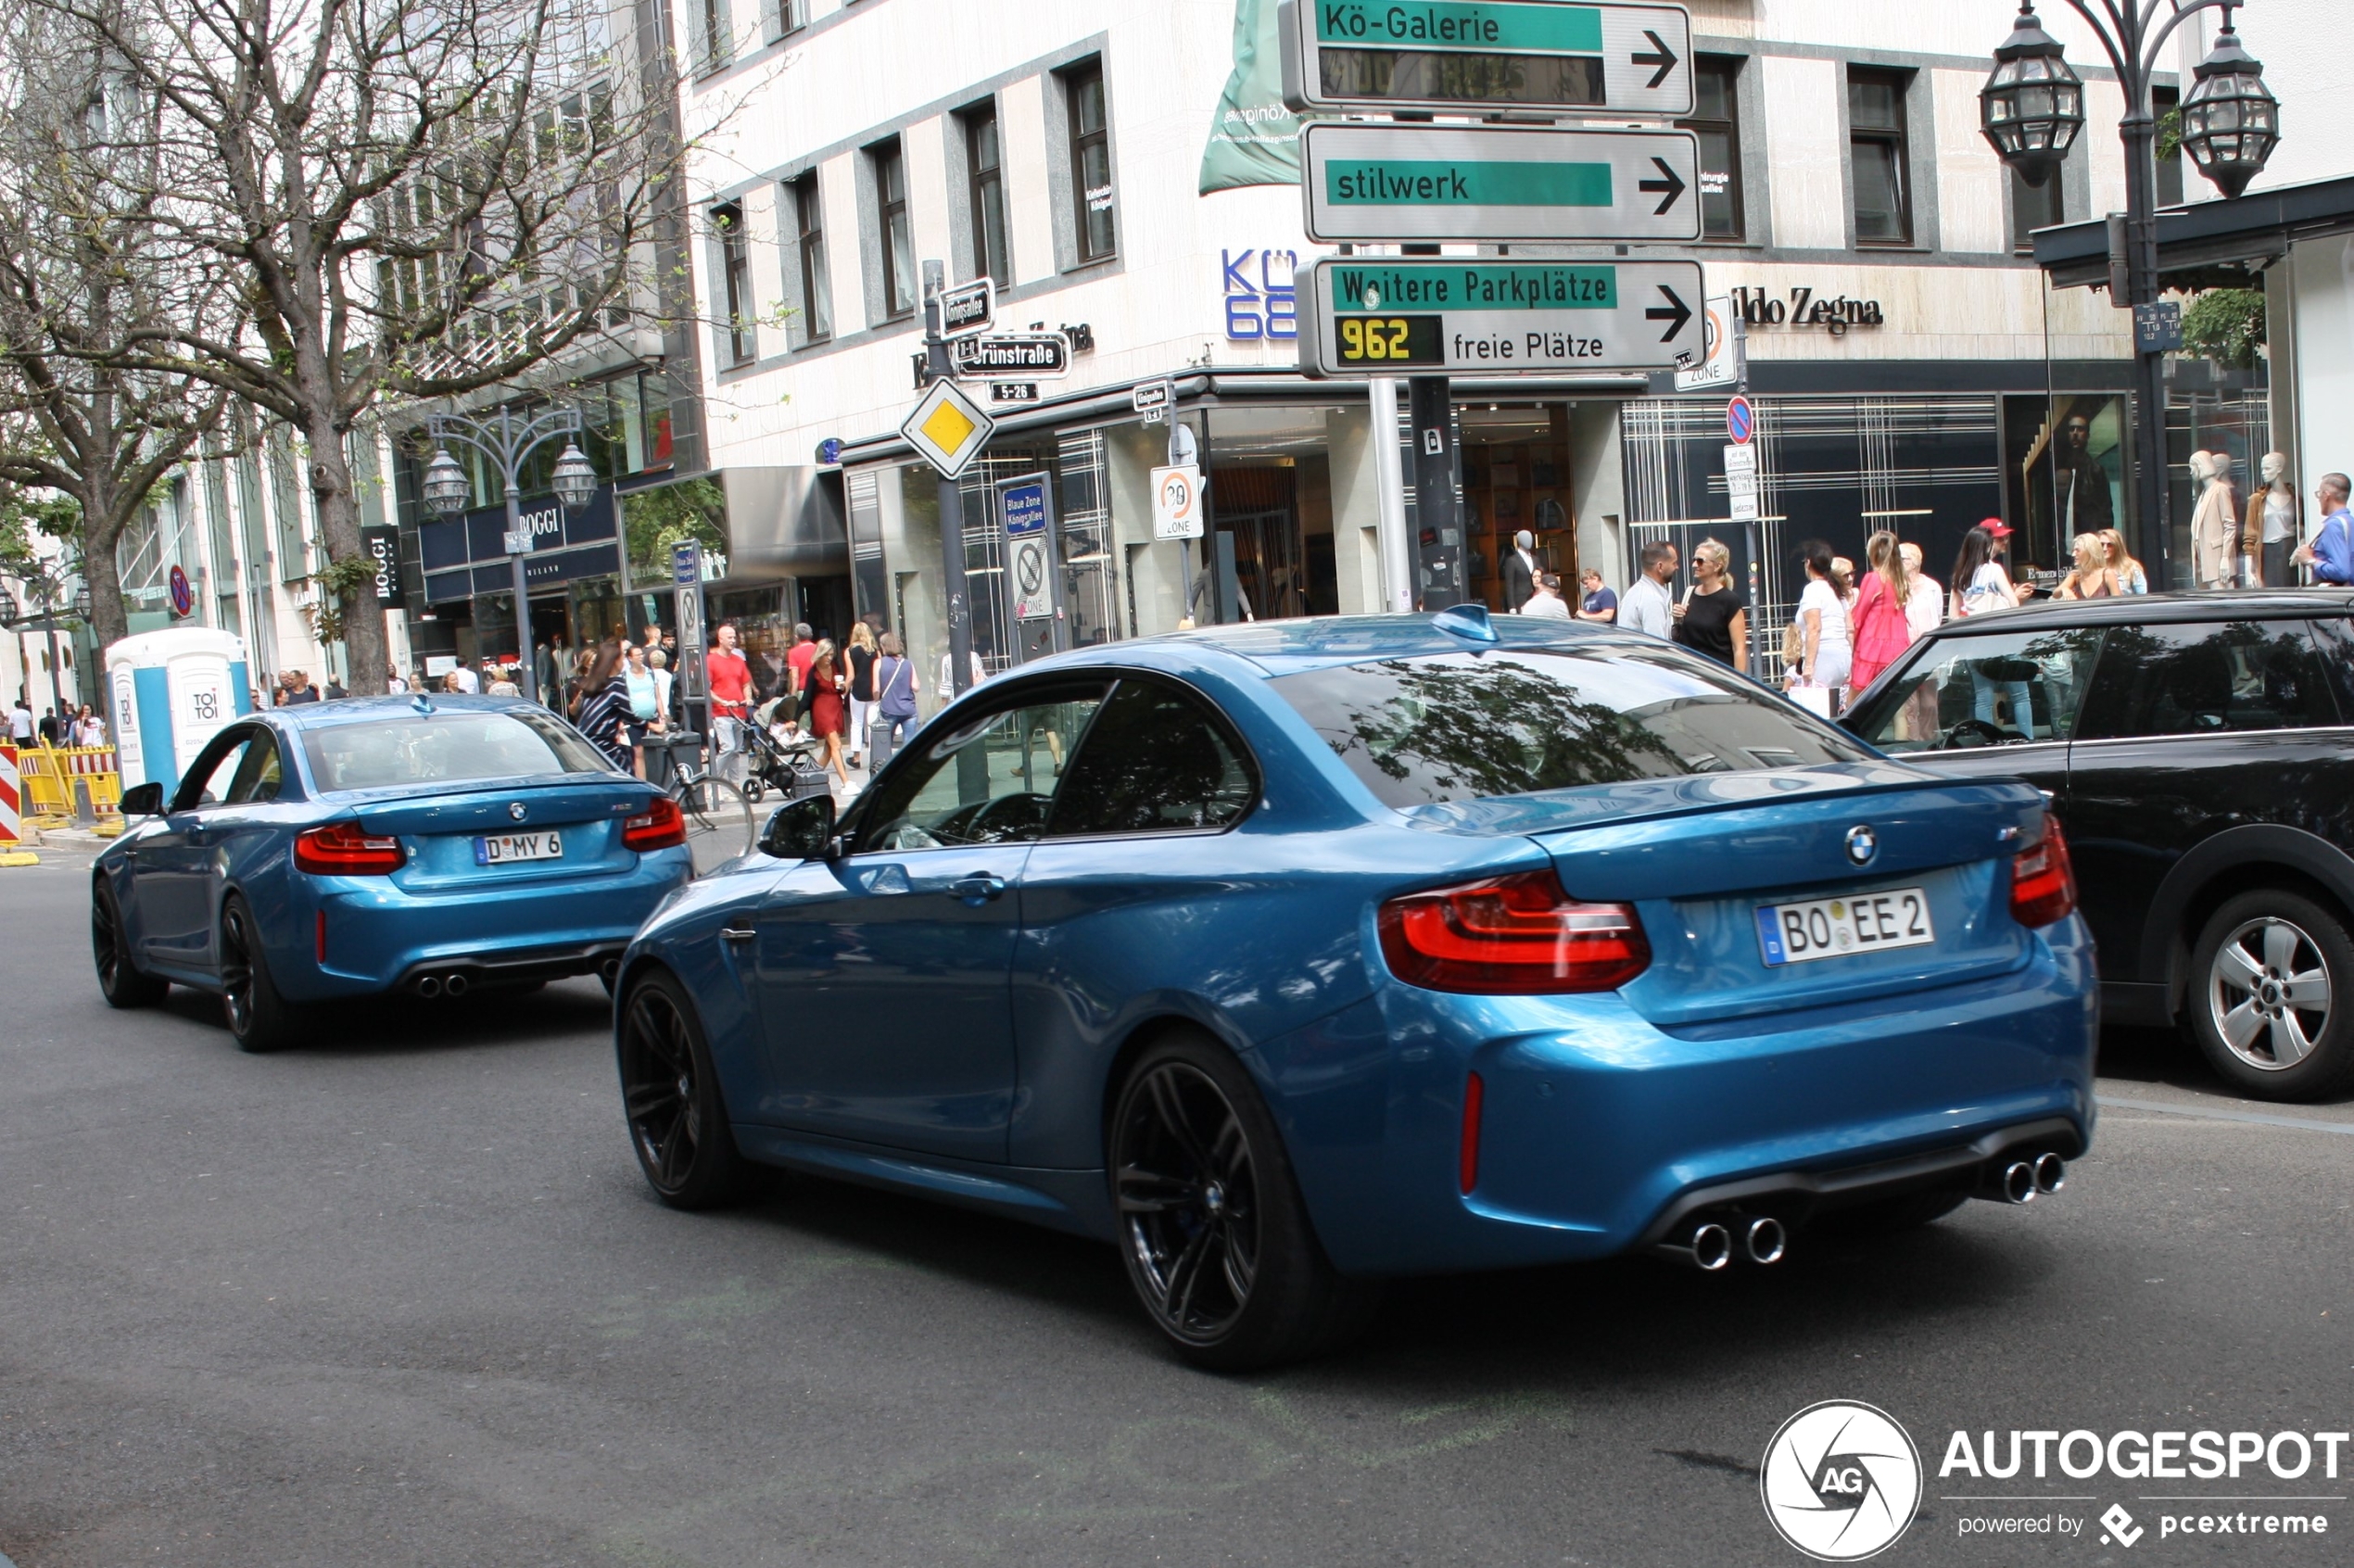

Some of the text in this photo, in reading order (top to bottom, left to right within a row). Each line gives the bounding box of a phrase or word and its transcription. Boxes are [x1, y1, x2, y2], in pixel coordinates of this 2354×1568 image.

[1325, 4, 1500, 42] Kö-Galerie
[1337, 167, 1470, 199] stilwerk
[1464, 270, 1608, 310] Parkplätze
[945, 296, 983, 324] Königsallee
[1224, 295, 1298, 338] 68
[1790, 286, 1884, 336] Zegna
[1342, 319, 1410, 360] 962
[1454, 332, 1604, 360] freie Plätze
[972, 344, 1055, 365] rünstraße
[1001, 385, 1028, 399] 5-26
[1006, 495, 1041, 511] Blaue Zone
[518, 508, 559, 538] BOGGI
[1006, 510, 1044, 526] Königsallee
[372, 537, 390, 598] BOGGI
[526, 564, 559, 576] MILANO
[193, 692, 218, 706] TOI
[195, 706, 219, 719] TOI
[487, 834, 560, 860] D MY 6
[1781, 894, 1926, 953] BO EE 2
